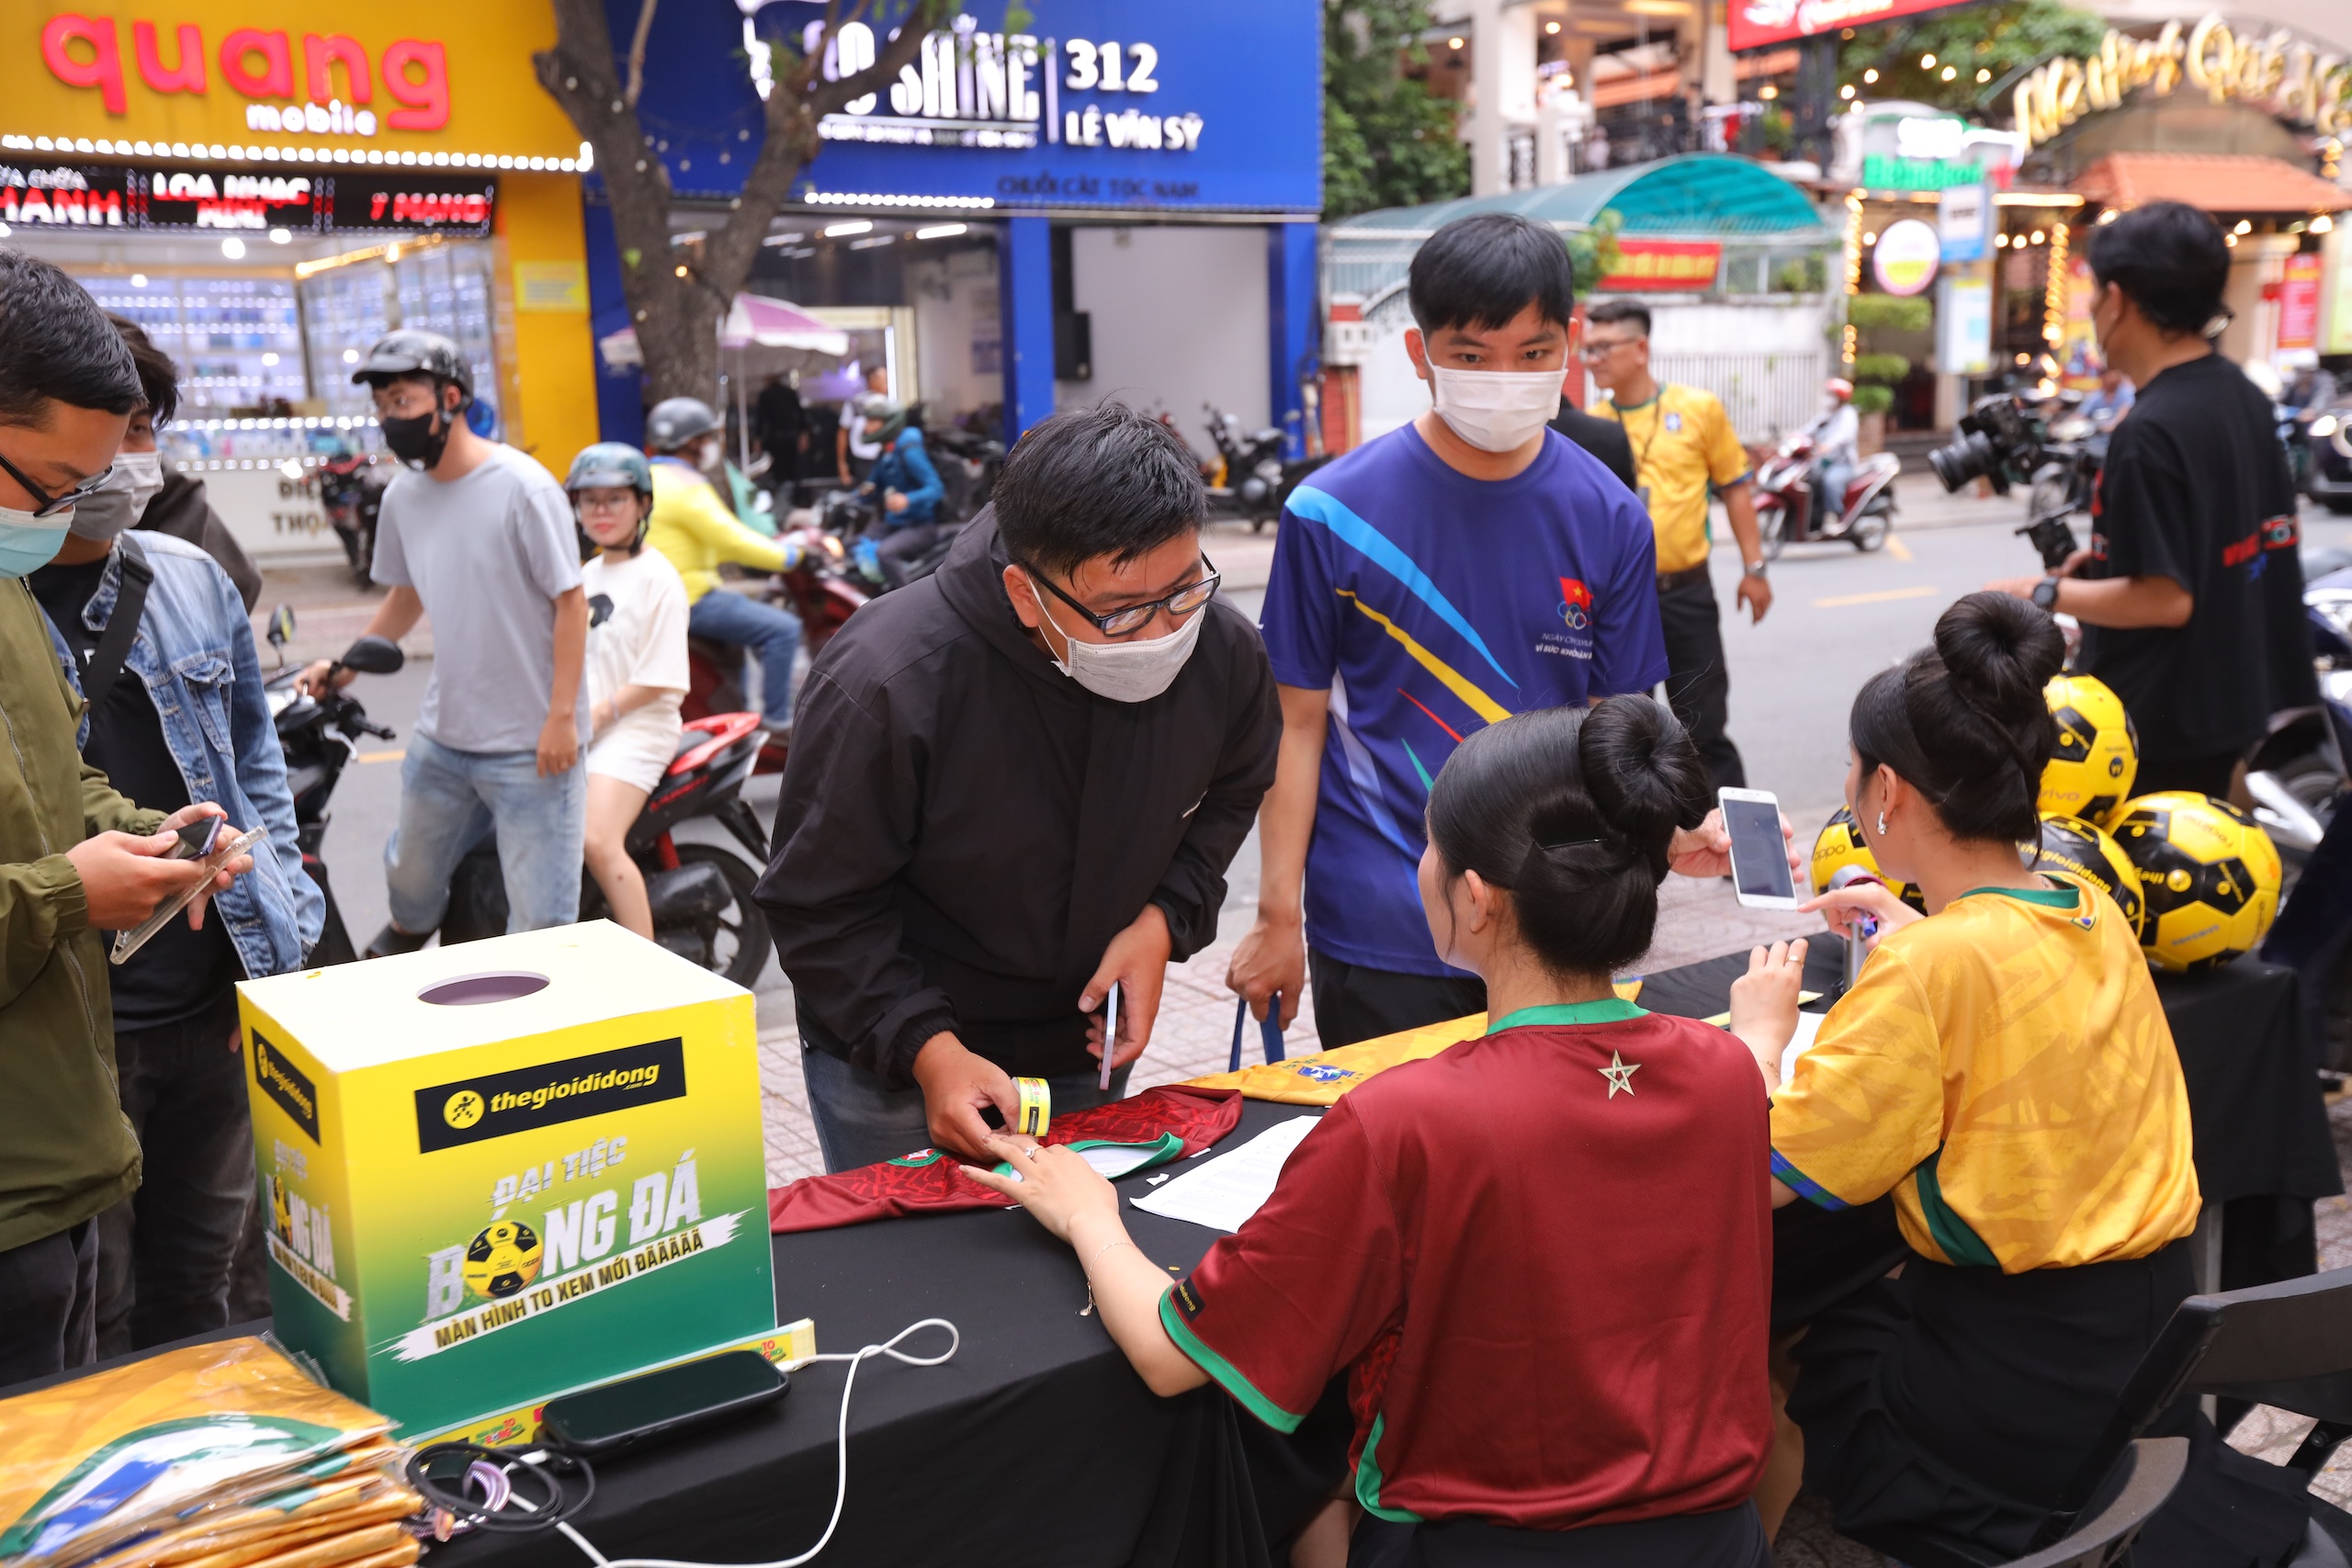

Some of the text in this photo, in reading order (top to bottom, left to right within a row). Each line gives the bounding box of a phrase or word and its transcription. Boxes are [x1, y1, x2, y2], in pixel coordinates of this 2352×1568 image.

[41, 13, 449, 130] quang
[1065, 39, 1159, 93] 312
[246, 99, 378, 136] mobile
[1065, 104, 1103, 146] LÊ
[490, 1063, 661, 1112] thegioididong
[488, 1136, 628, 1207] ĐẠI TIỆC
[628, 1148, 703, 1246] ĐÁ
[435, 1321, 478, 1350] MÀN
[481, 1296, 526, 1330] HÌNH
[529, 1288, 553, 1312] TO
[556, 1275, 595, 1302] XEM
[597, 1256, 632, 1286] MỚI
